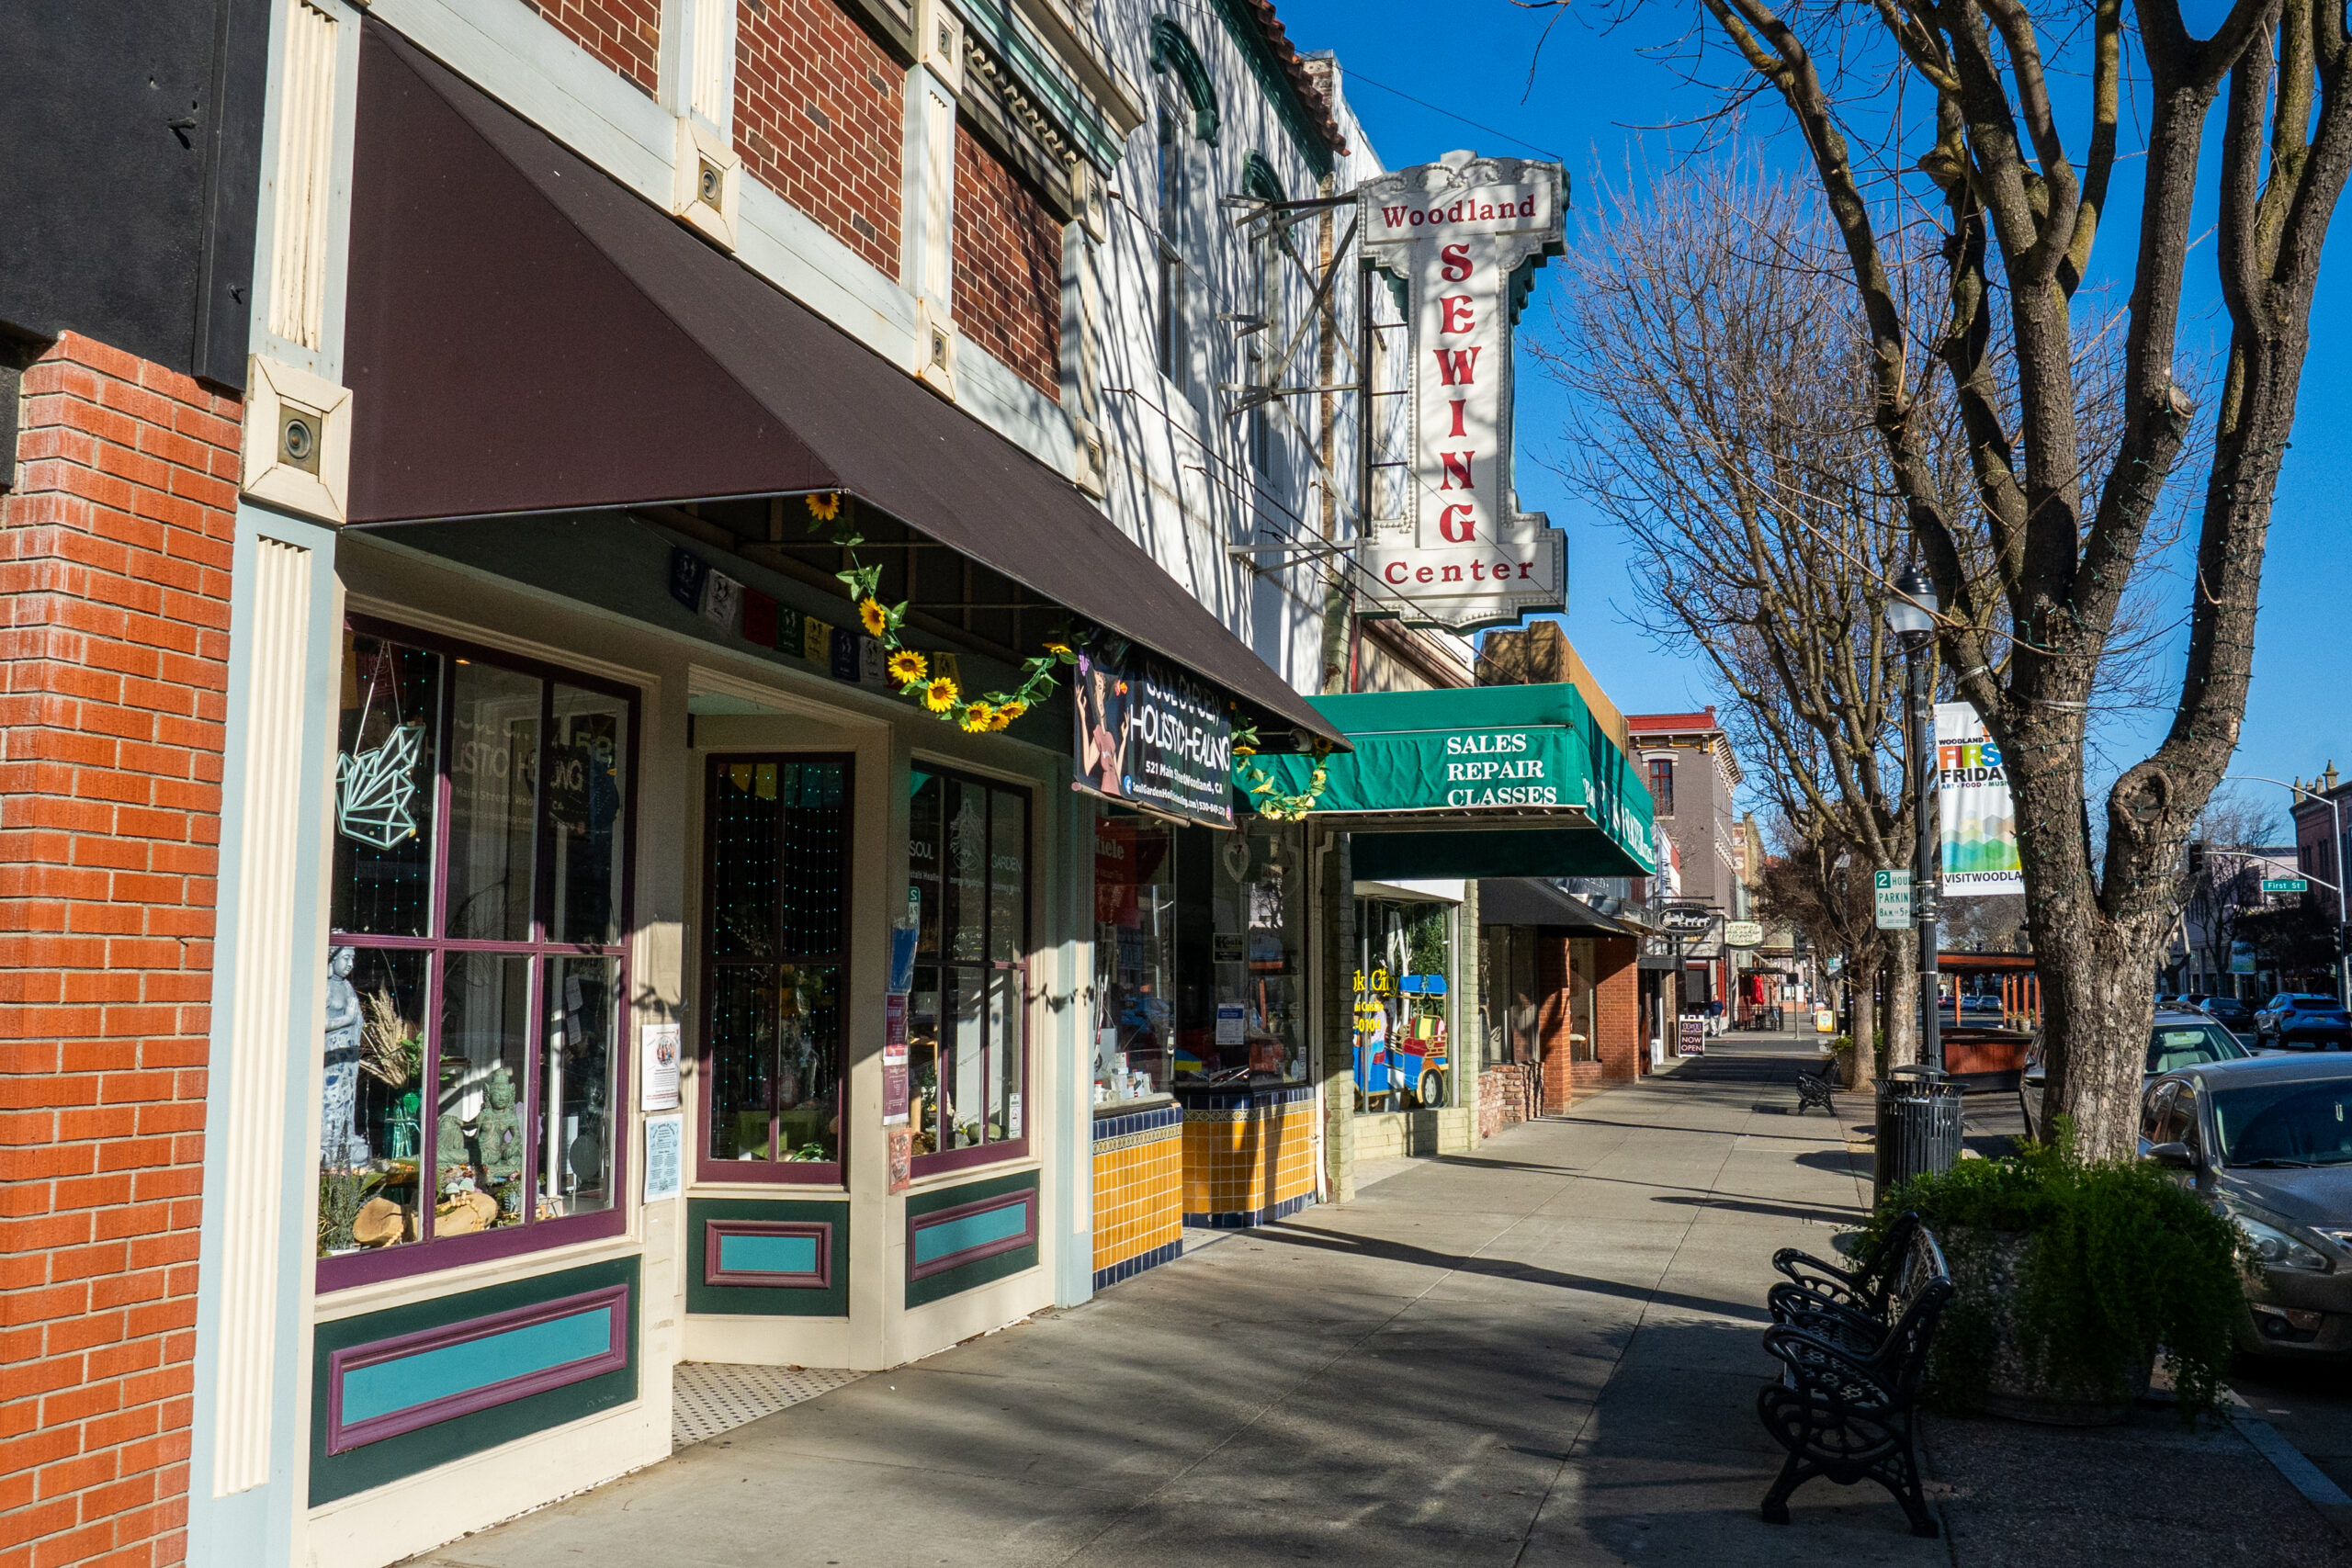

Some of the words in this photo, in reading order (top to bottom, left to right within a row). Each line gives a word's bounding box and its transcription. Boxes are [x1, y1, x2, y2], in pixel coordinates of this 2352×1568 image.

[1381, 194, 1536, 229] Woodland
[1432, 243, 1482, 543] SEWING
[1384, 558, 1534, 585] Center
[1446, 733, 1527, 755] SALES
[1939, 743, 2002, 769] FIRS
[1145, 761, 1159, 775] 521
[1159, 763, 1174, 779] Main
[1215, 782, 1224, 795] CA
[1447, 760, 1544, 781] REPAIR
[1940, 767, 2005, 783] FRIDA
[1447, 786, 1557, 807] CLASSES
[909, 840, 934, 860] SOUL
[990, 852, 1023, 874] GARDEN
[1878, 874, 1888, 886] 2
[1944, 871, 2023, 883] VISITWOODLA
[1879, 893, 1914, 903] PARKING
[1371, 968, 1400, 998] City
